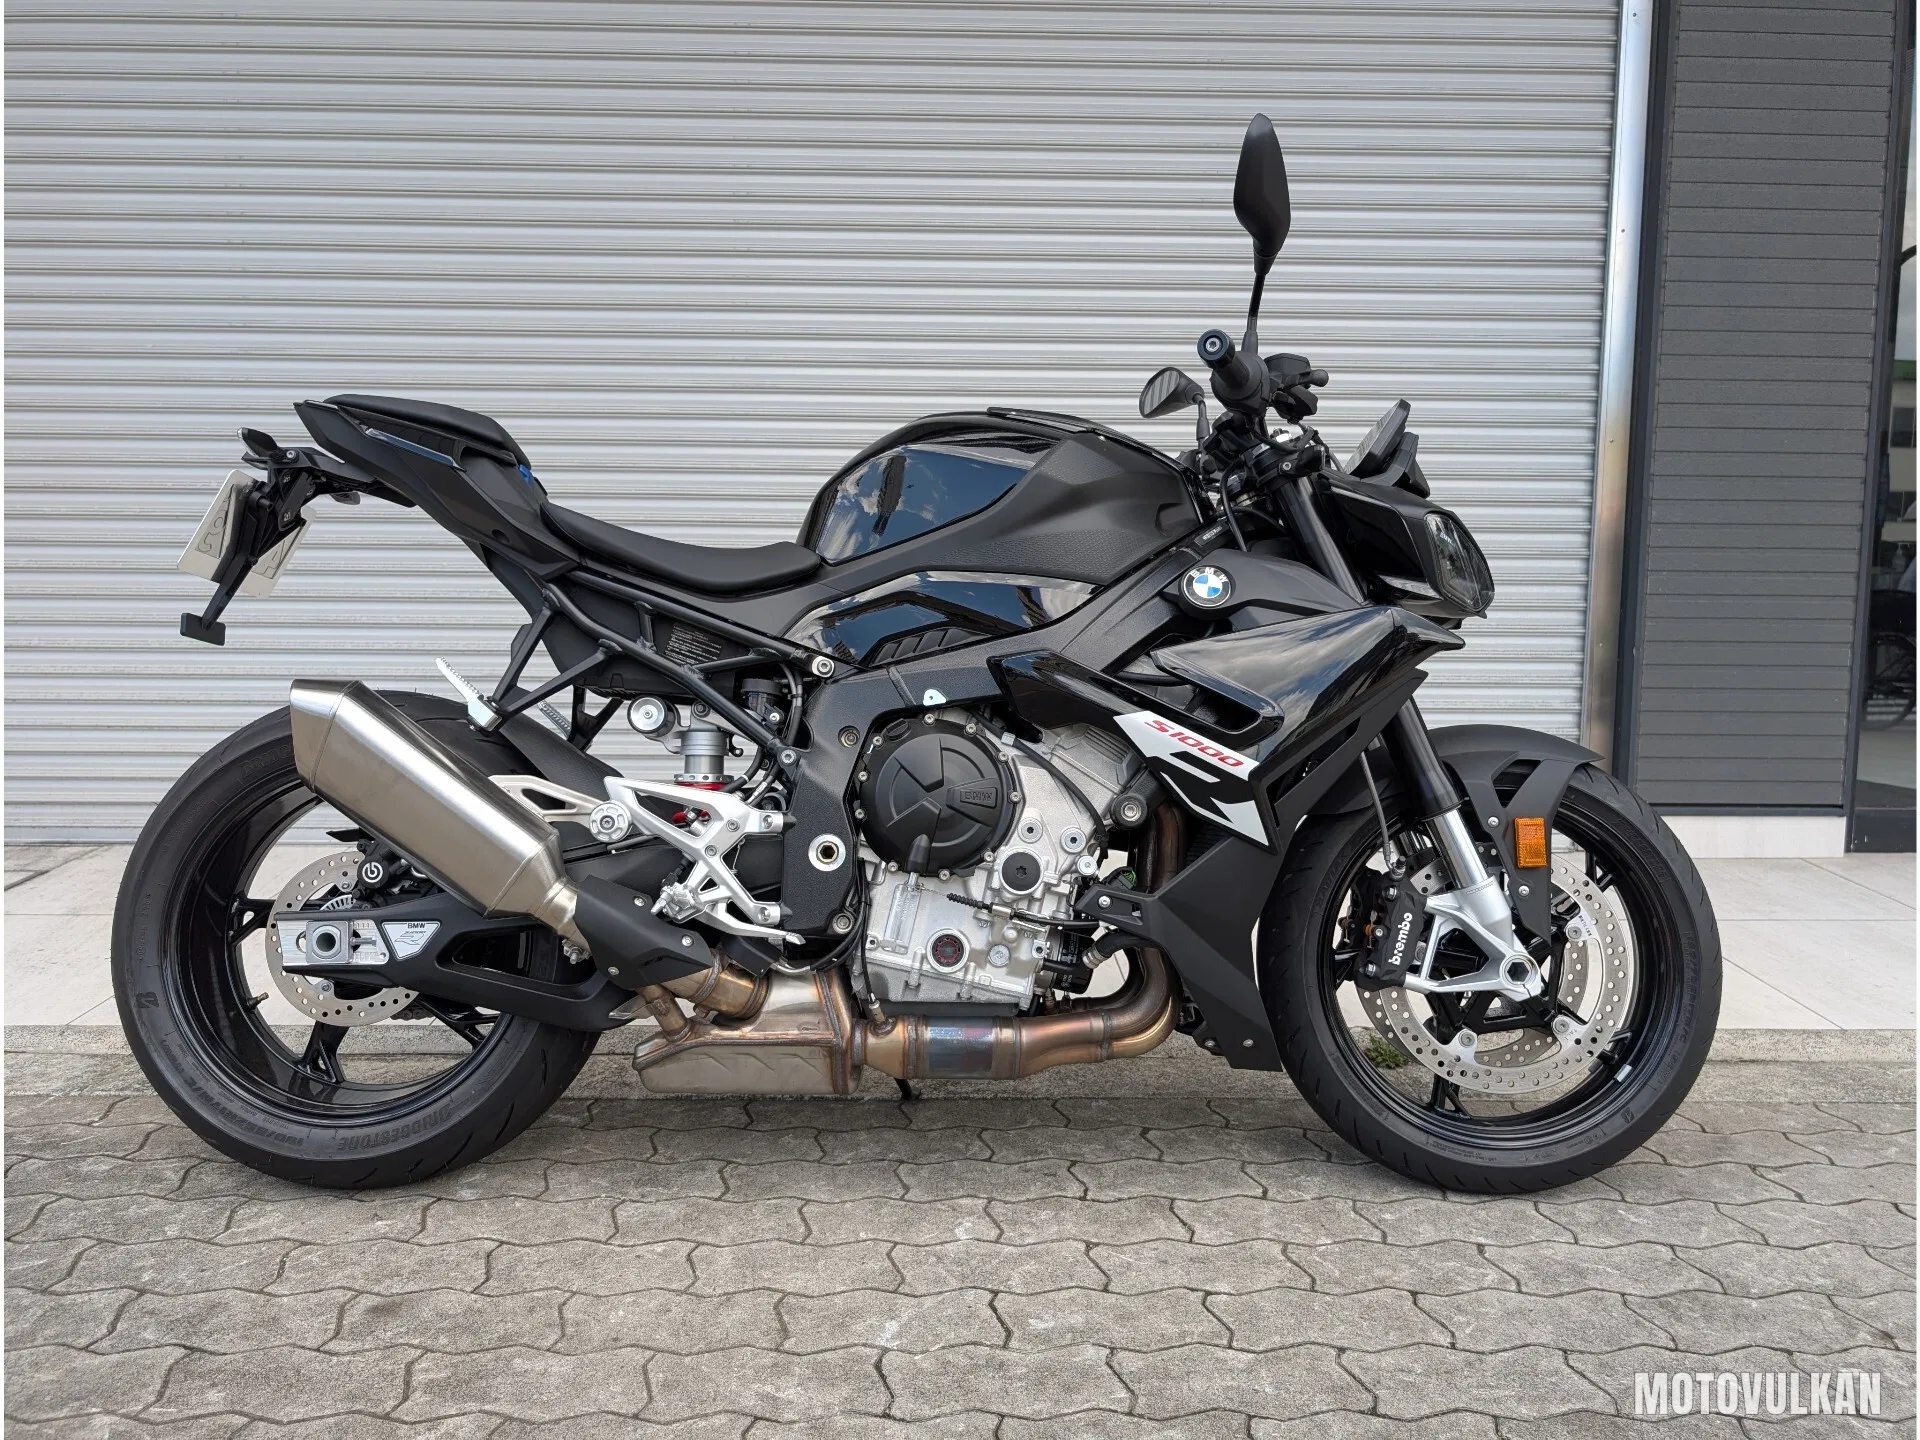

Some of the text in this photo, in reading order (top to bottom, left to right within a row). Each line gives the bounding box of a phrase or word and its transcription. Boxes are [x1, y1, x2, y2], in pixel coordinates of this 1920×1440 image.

[1190, 567, 1228, 582] BMW
[1144, 719, 1245, 768] S1000
[1388, 912, 1413, 965] brembo
